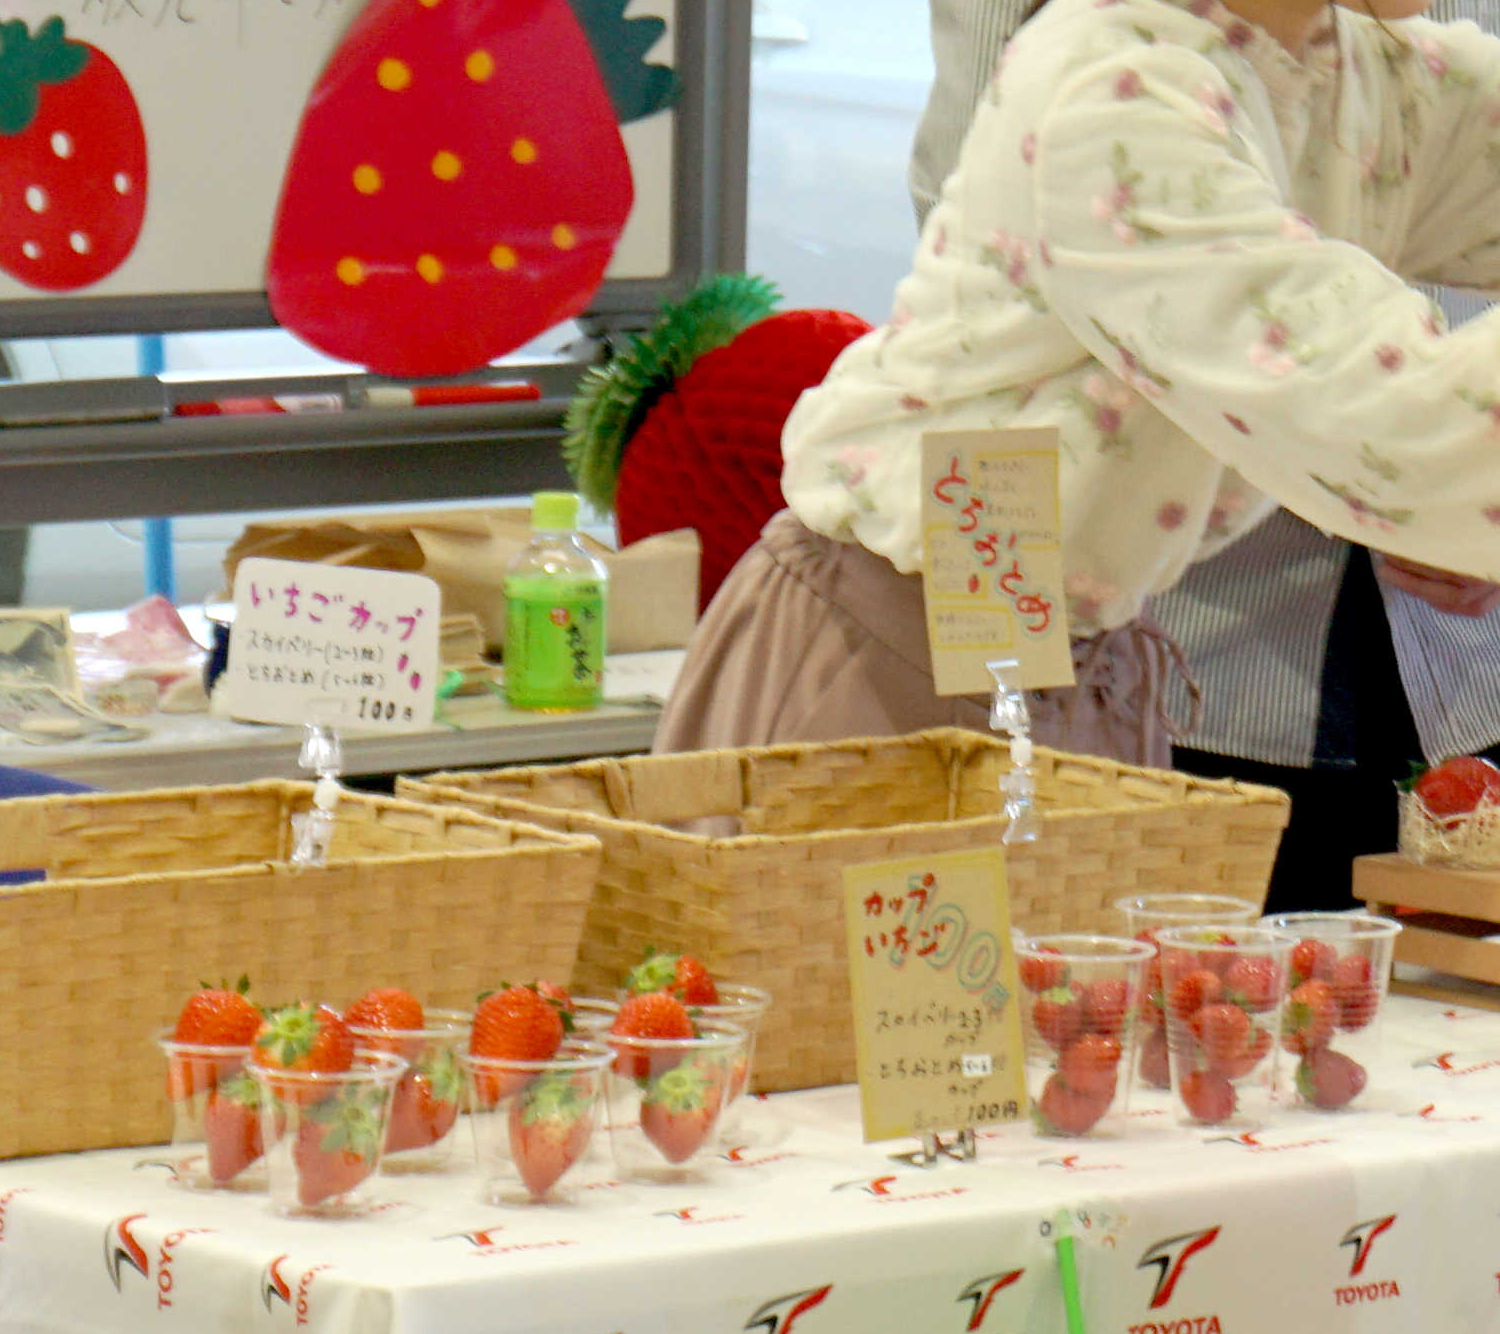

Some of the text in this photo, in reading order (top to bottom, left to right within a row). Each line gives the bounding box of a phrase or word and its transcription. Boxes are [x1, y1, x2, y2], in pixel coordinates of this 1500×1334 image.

[251, 581, 424, 642] いちごカップ
[863, 871, 936, 917] カップ
[864, 920, 947, 958] いちご
[1333, 1279, 1401, 1305] TOYOTA
